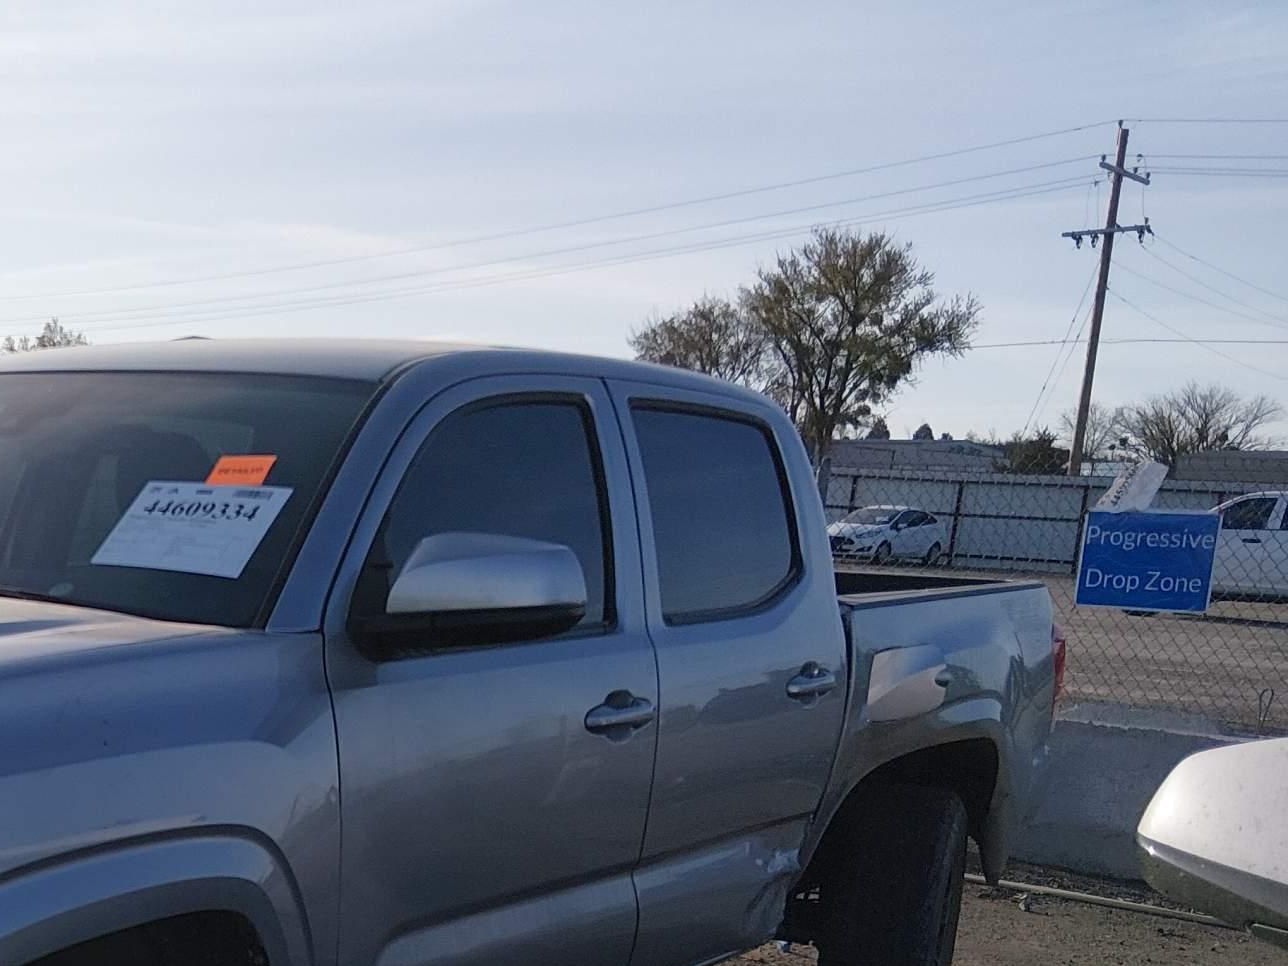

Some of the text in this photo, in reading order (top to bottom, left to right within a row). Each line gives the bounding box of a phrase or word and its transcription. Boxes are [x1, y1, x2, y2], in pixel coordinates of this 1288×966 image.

[144, 500, 260, 521] 44609334
[1086, 525, 1215, 550] Progressive
[1085, 568, 1202, 593] Drop Zone
